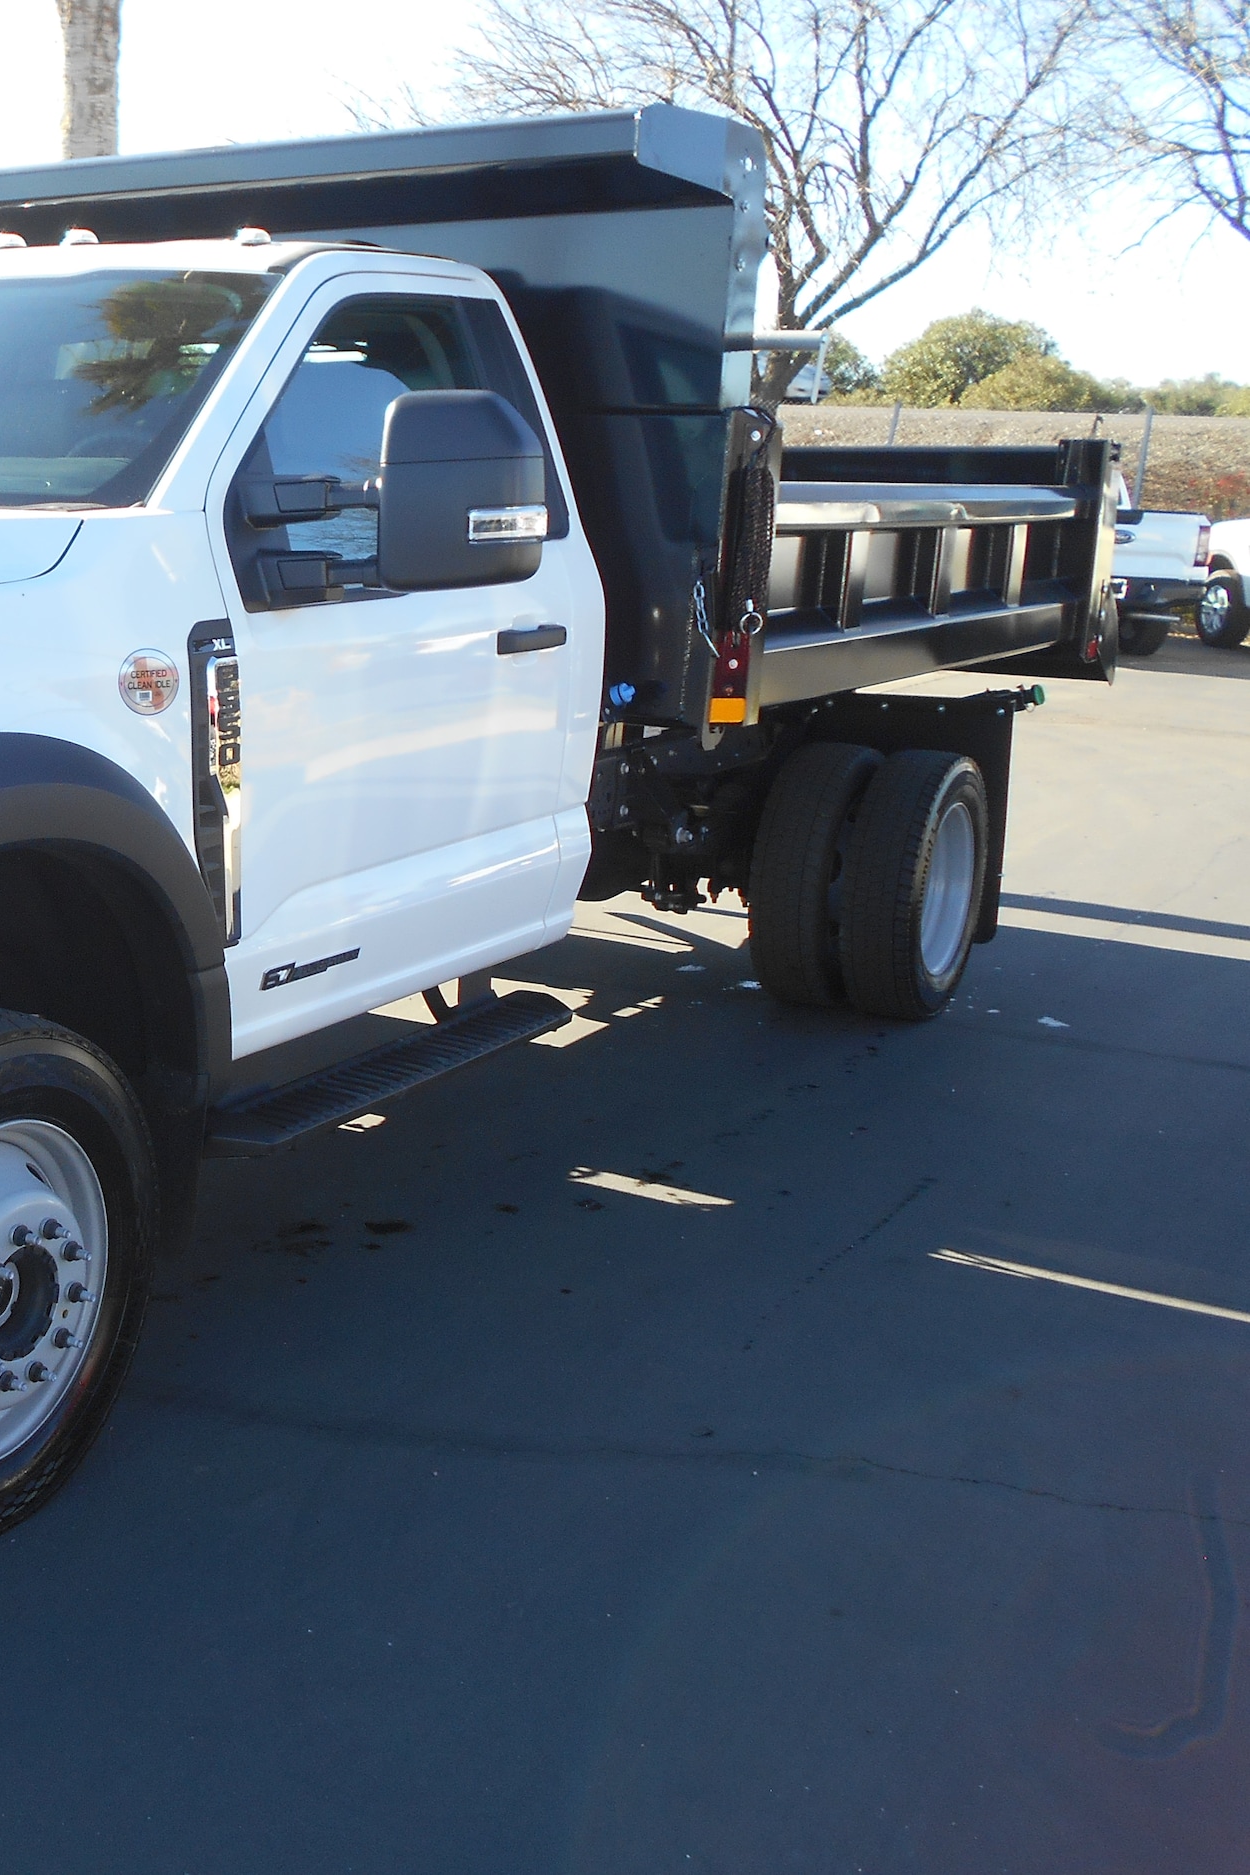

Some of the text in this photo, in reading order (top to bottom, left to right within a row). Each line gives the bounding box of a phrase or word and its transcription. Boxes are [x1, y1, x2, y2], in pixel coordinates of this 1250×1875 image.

[211, 637, 232, 651] XL
[130, 669, 168, 679] CERTIFIED
[127, 681, 152, 691] CLEAN
[154, 679, 171, 689] IDLE
